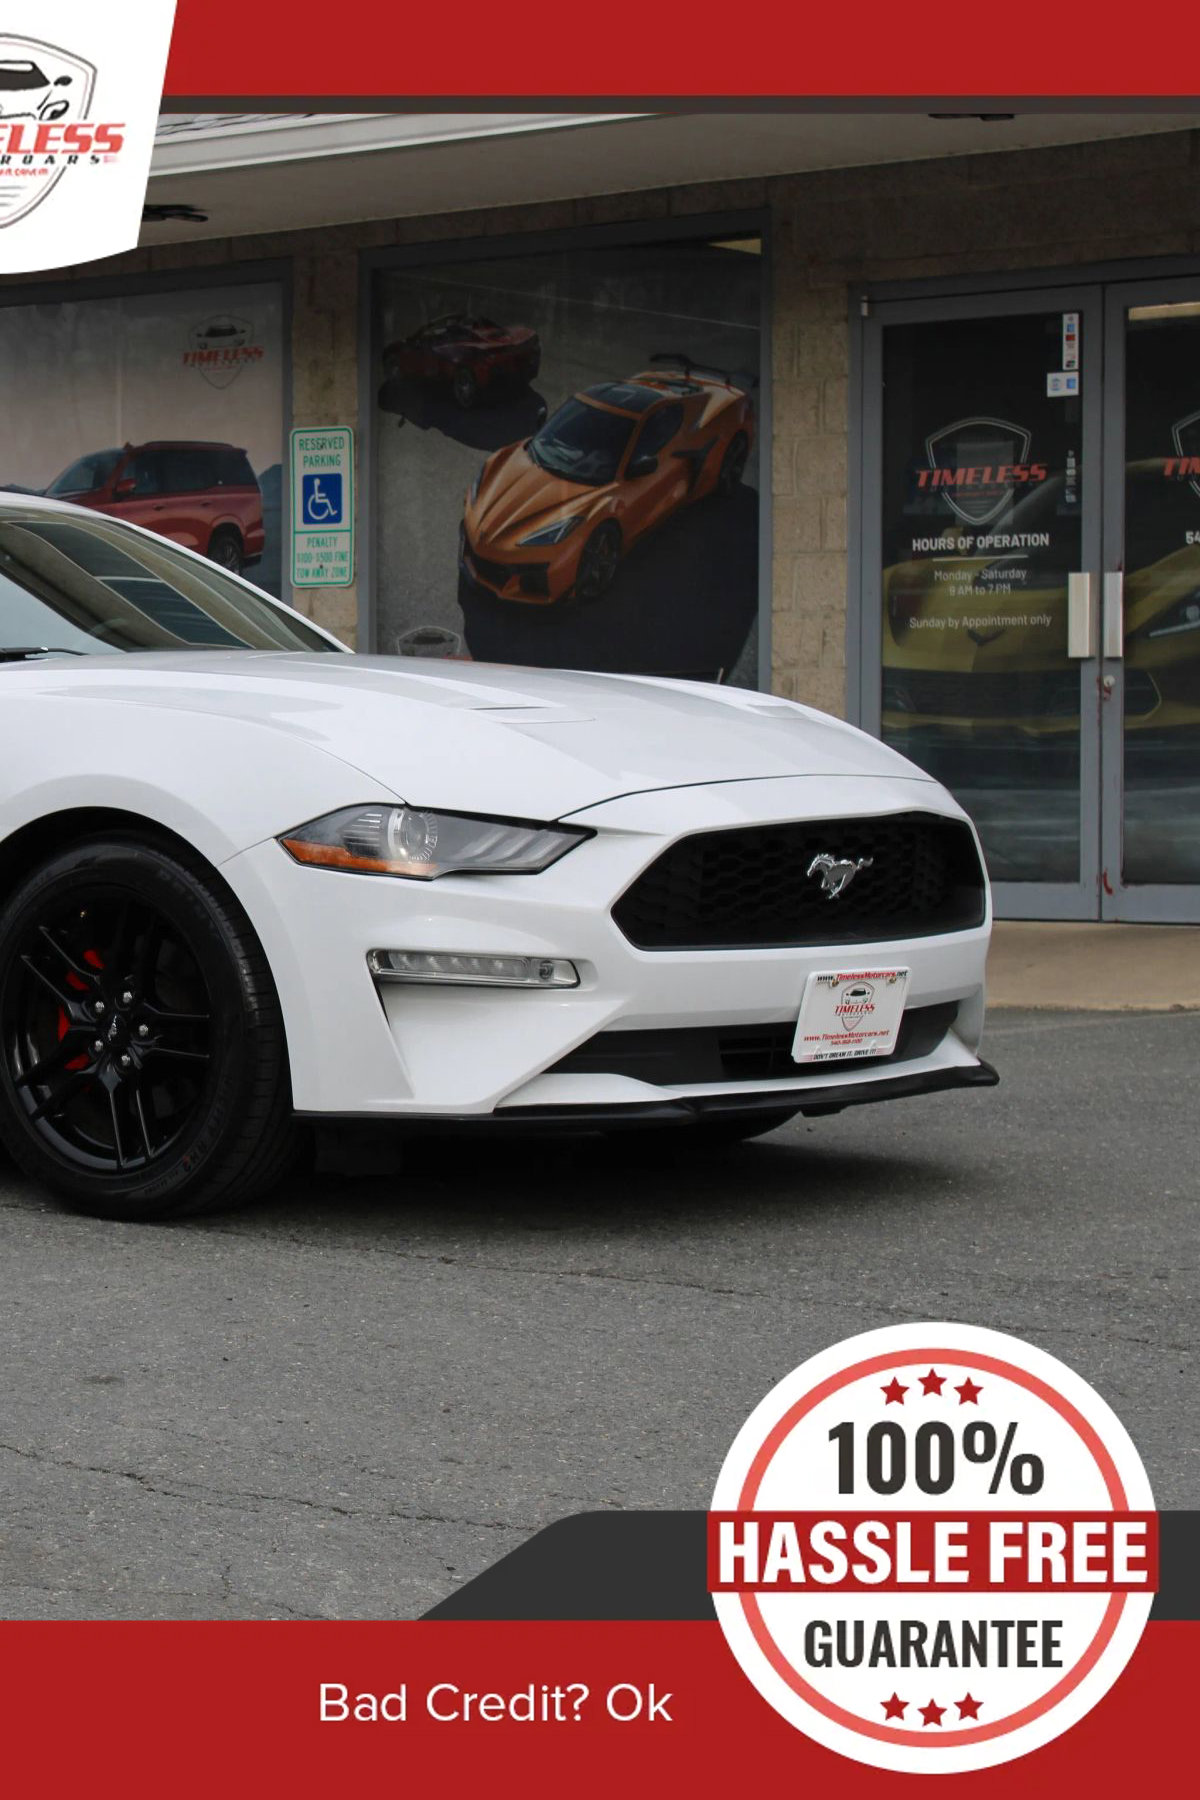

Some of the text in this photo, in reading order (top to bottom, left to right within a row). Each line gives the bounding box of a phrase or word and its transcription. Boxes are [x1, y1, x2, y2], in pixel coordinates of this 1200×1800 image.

[299, 437, 344, 450] RESERVED
[303, 454, 341, 468] PARKING
[916, 463, 1048, 487] TIMELESS
[306, 536, 338, 548] PENALTY
[912, 533, 1049, 551] HOURS OF OPERATION
[934, 570, 972, 584] Monday
[981, 568, 1027, 582] Saturday
[957, 586, 974, 596] AM
[975, 586, 986, 596] to
[988, 585, 995, 595] 7
[996, 584, 1011, 594] PM
[909, 614, 1052, 630] Sunday by Appointment only
